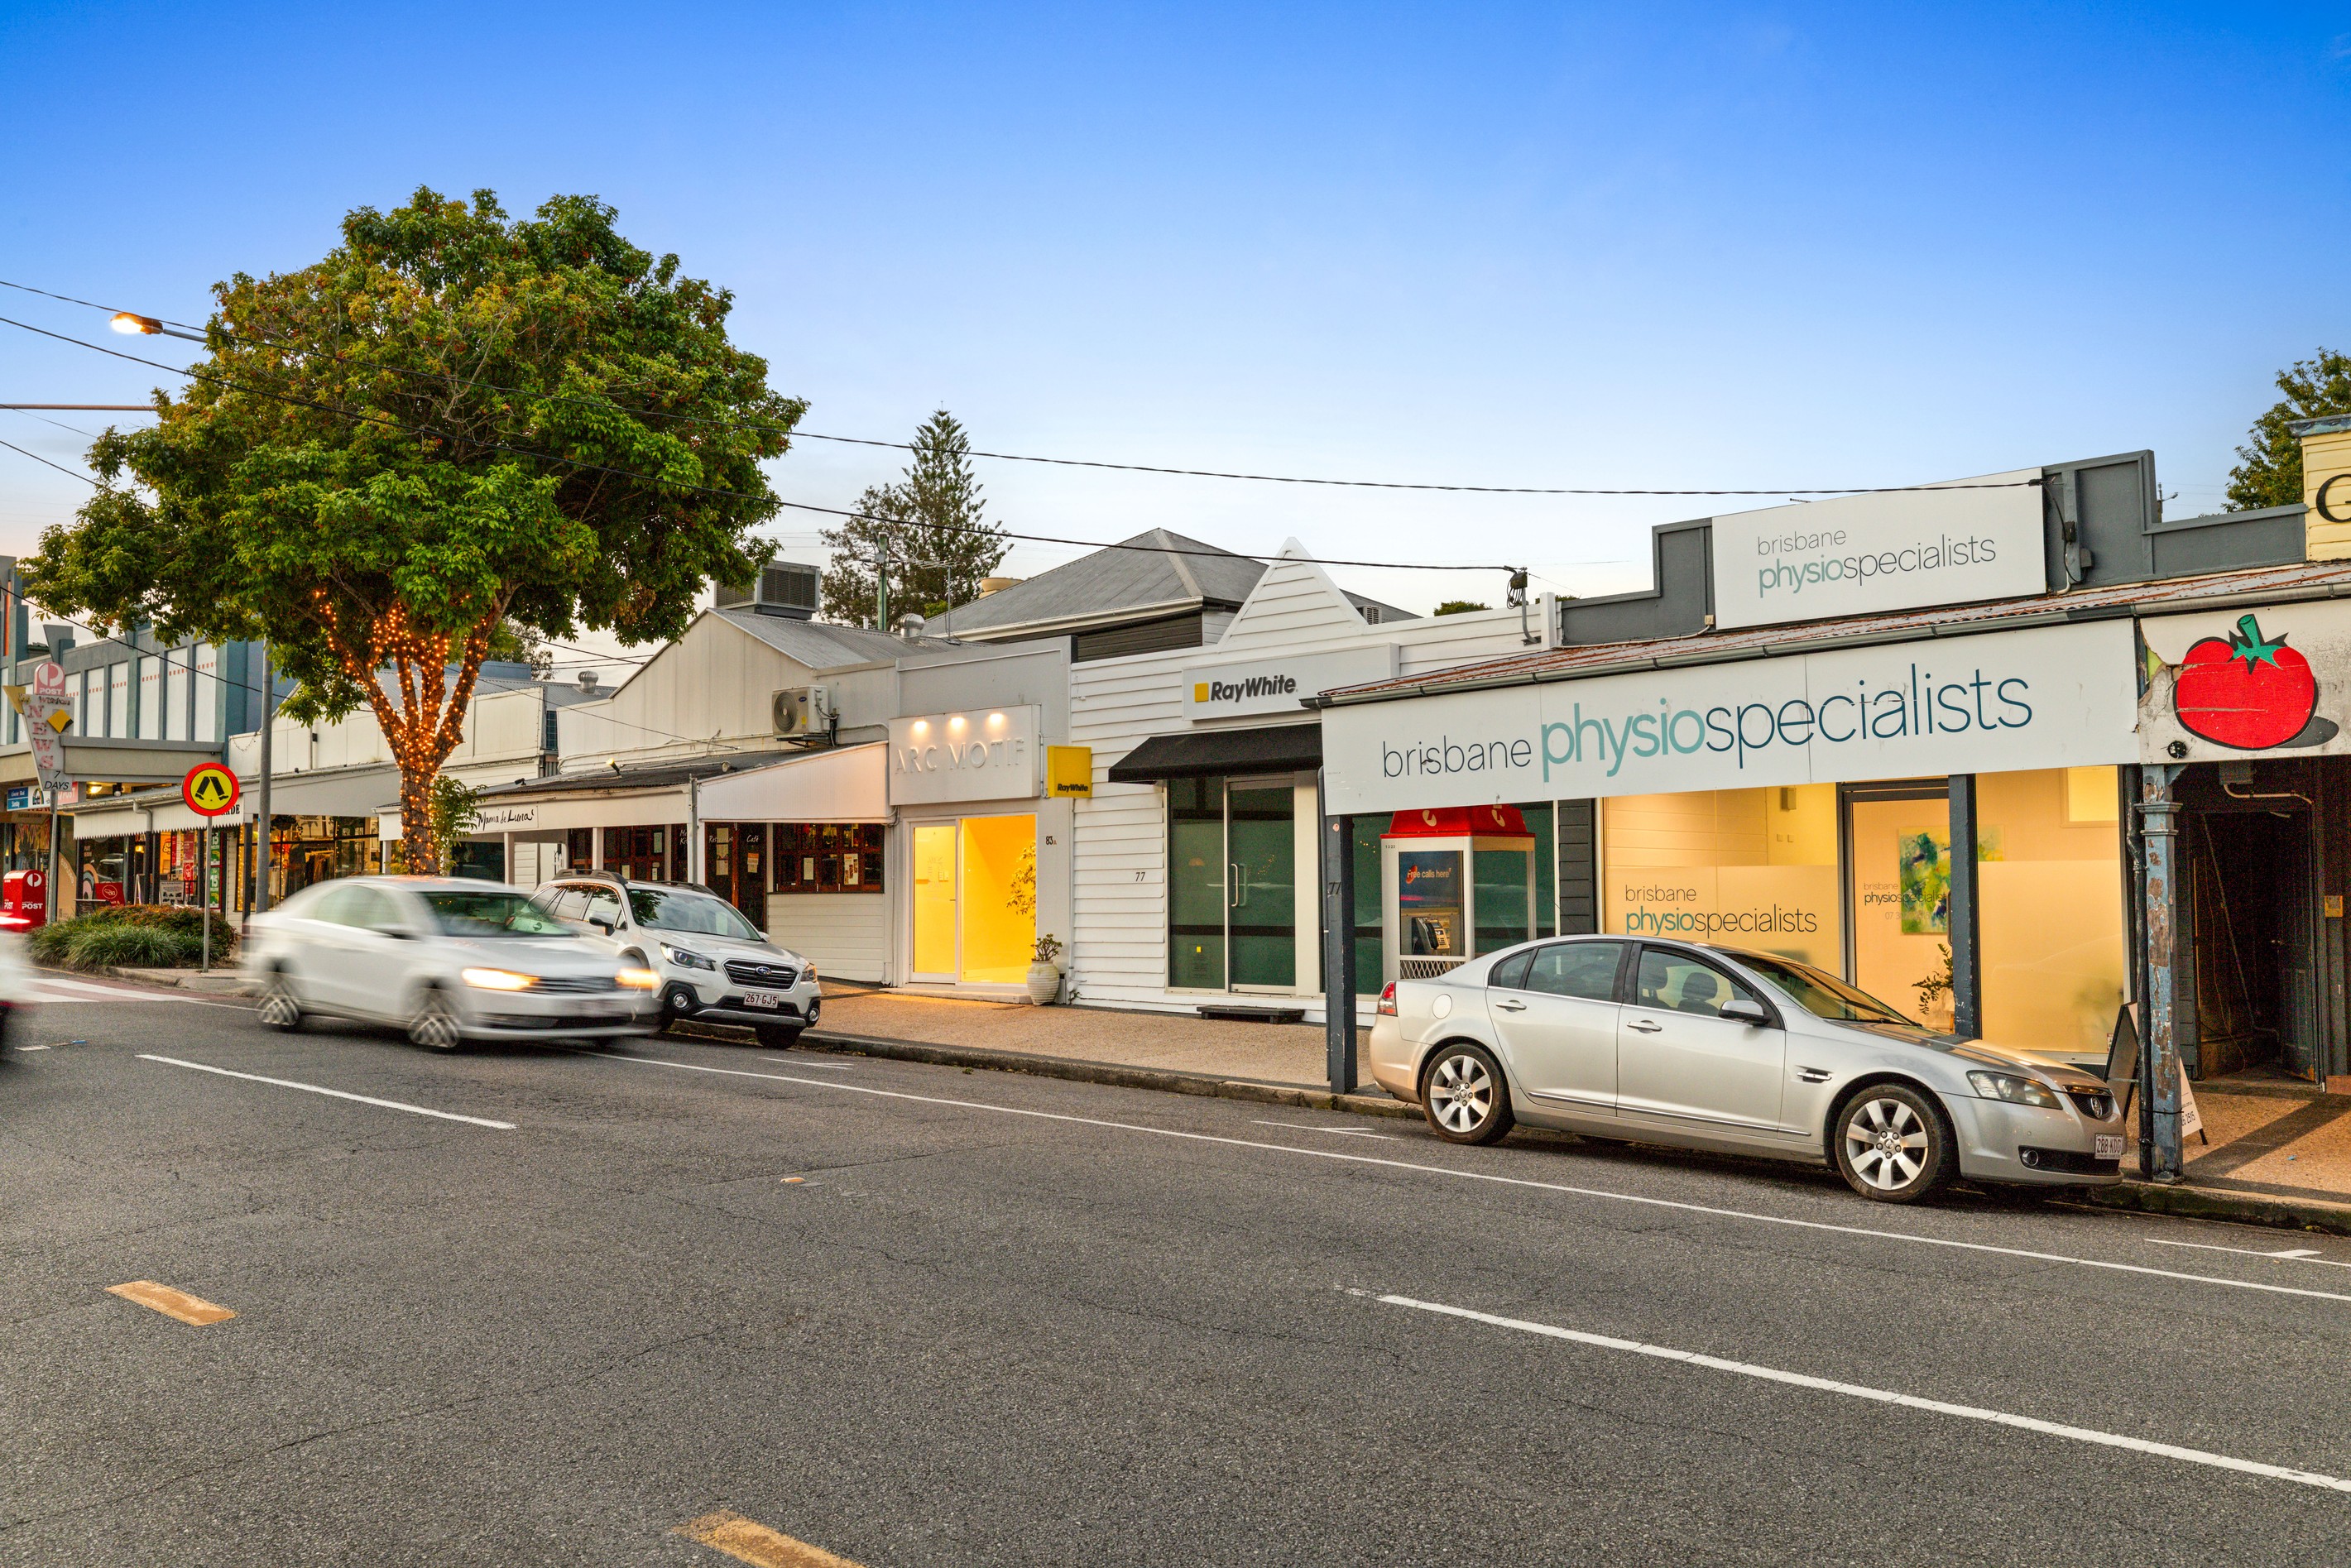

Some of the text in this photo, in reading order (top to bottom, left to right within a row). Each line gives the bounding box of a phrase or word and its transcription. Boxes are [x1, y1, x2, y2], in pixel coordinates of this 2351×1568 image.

[1758, 530, 1846, 555] brisbane
[1759, 535, 1996, 598] physiospecialists
[1384, 663, 2033, 783] brisbane physiospecialists
[895, 737, 1024, 774] ARC MOTIF
[54, 770, 61, 779] 7
[44, 780, 70, 790] DAYS
[1135, 871, 1146, 882] 77
[1624, 884, 1696, 902] brisbane
[1864, 882, 1898, 890] brisbane
[1864, 889, 1947, 906] physiospecialist
[1626, 904, 1818, 938] physiospecialists
